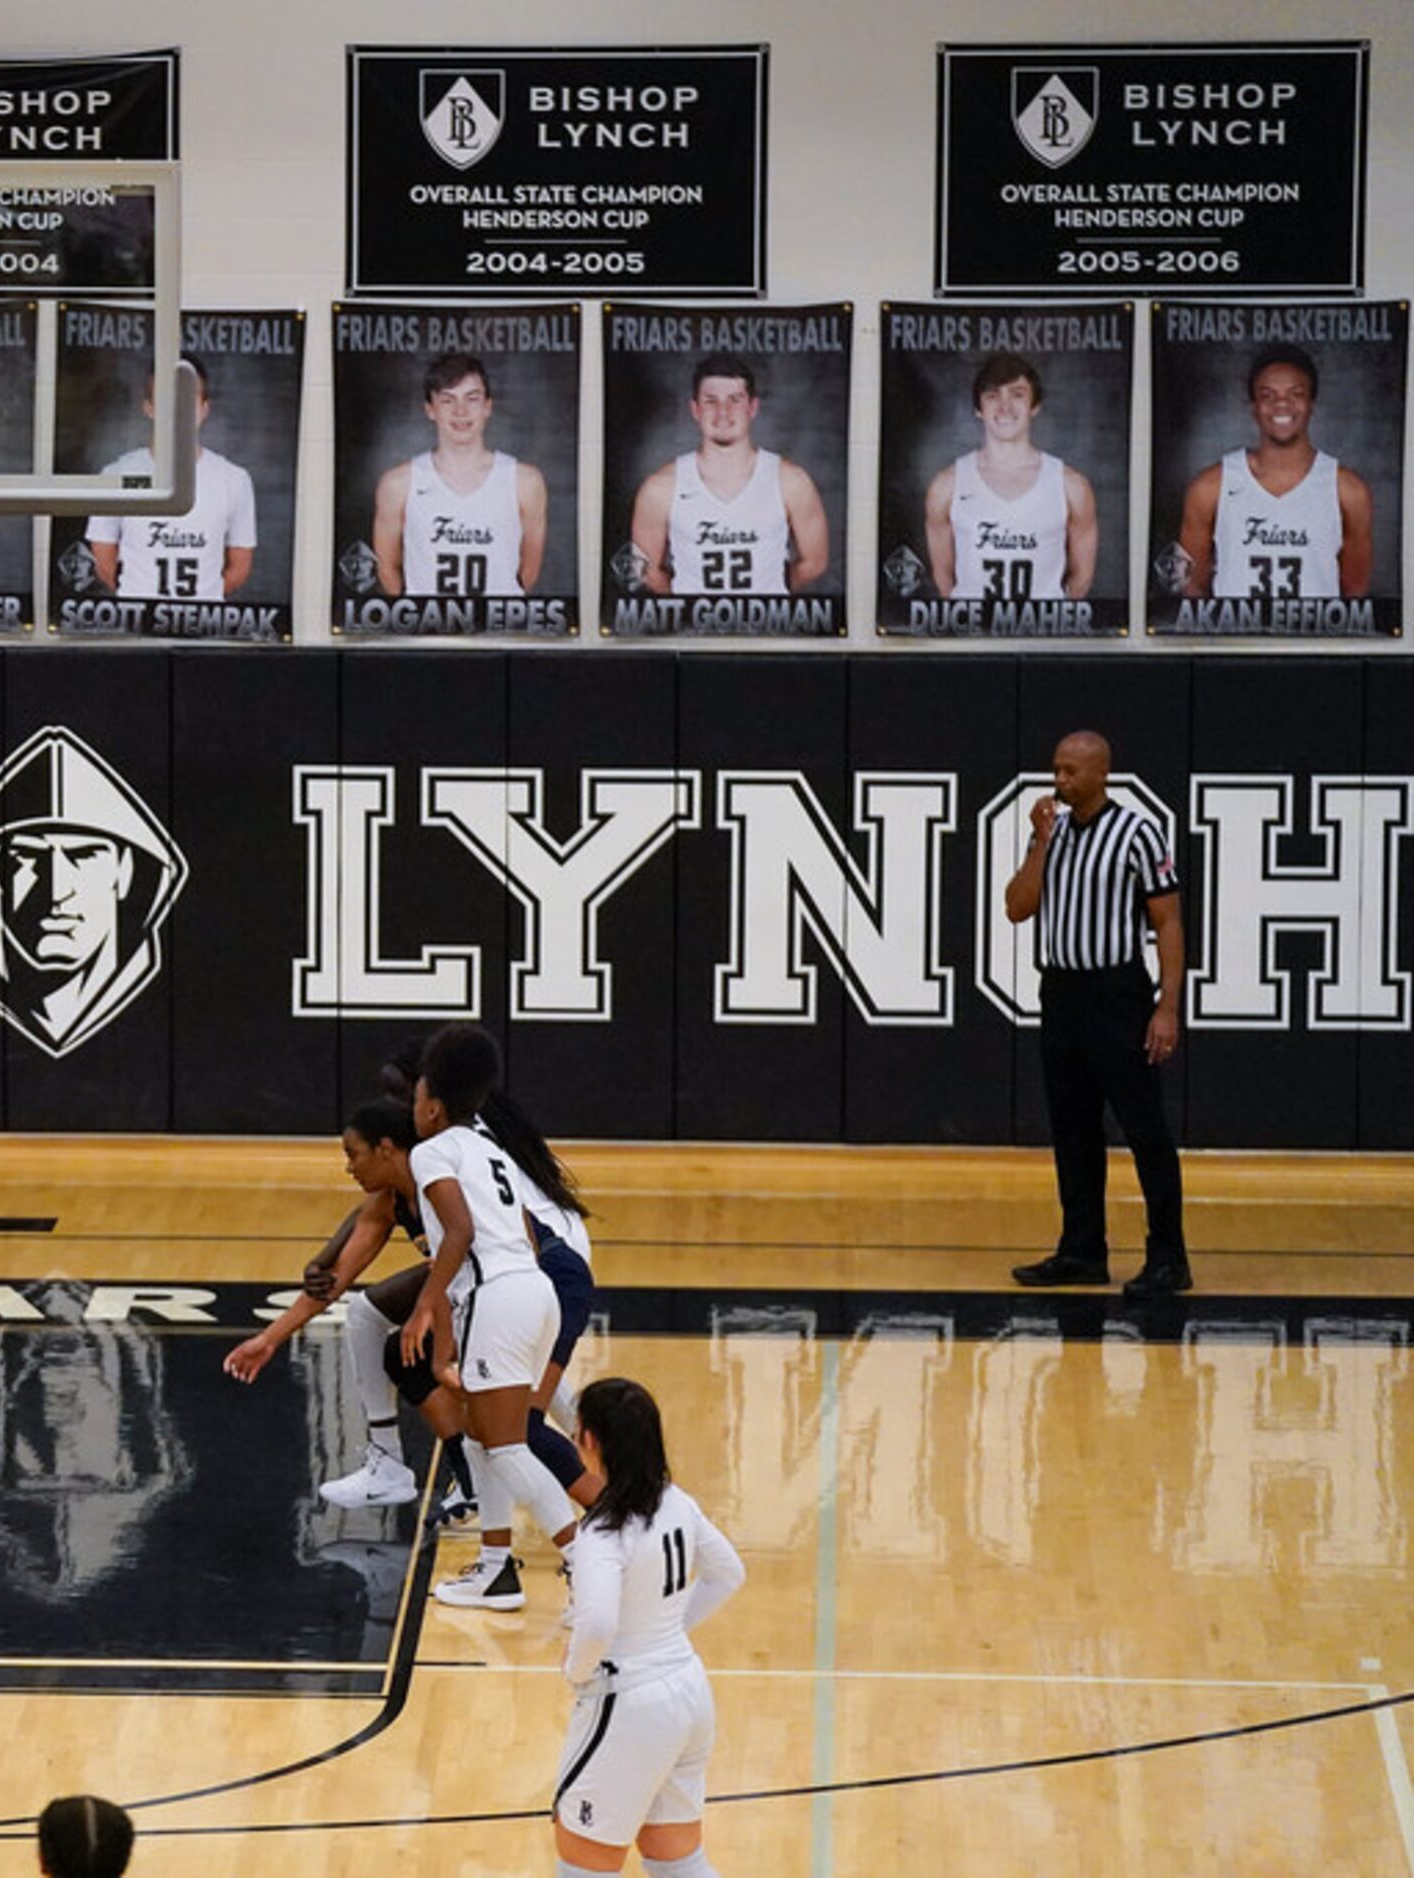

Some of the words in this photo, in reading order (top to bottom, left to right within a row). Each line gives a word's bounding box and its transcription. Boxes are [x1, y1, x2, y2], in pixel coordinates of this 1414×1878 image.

[529, 87, 699, 111] BISHOP
[1123, 84, 1297, 109] BISHOP
[538, 123, 688, 148] LYNCH
[1132, 120, 1286, 146] LYNCH
[410, 185, 509, 204] OVERALL
[513, 185, 576, 204] STATE
[582, 185, 702, 204] CHAMPION
[1001, 184, 1101, 203] OVERALL
[1107, 184, 1171, 203] STATE
[1176, 184, 1299, 203] CHAMPION
[18, 212, 63, 230] CUP
[463, 210, 599, 229] HENDERSON
[603, 210, 649, 229] CUP
[1054, 208, 1192, 228] HENDERSON
[1197, 208, 1244, 228] CUP
[466, 252, 645, 274] 2004-2005
[1057, 250, 1240, 273] 2005-2006
[65, 311, 146, 348] FRIARS
[180, 318, 295, 353] SKETBALL
[336, 315, 420, 352] FRIARS
[427, 315, 574, 353] BASKETBALL
[612, 316, 692, 352] FRIARS
[700, 316, 843, 352] BASKETBALL
[890, 316, 971, 352] FRIARS
[979, 316, 1122, 352] BASKETBALL
[1167, 308, 1245, 341] FRIARS
[1253, 308, 1392, 342] BASKETBALL
[147, 521, 208, 549] Friars
[431, 516, 494, 545] Friars
[696, 520, 759, 546] Friars
[975, 521, 1038, 550] Friars
[1242, 516, 1310, 546] Friars
[156, 558, 199, 598] 15
[437, 553, 487, 596] 20
[702, 550, 752, 590] 22
[983, 559, 1033, 600] 30
[1250, 555, 1303, 599] 33
[60, 599, 146, 629] SCOTT
[153, 603, 279, 635] STEMPAK
[344, 598, 474, 633] LOGAN
[486, 600, 566, 634] EPES
[615, 598, 685, 631] MATT
[692, 599, 833, 634] GOLDMAN
[910, 601, 982, 633] DUCE
[991, 601, 1093, 635] MAHER
[1175, 599, 1263, 633] AKAN
[1271, 599, 1376, 634] EFFIOM
[487, 1157, 515, 1206] 5
[662, 1527, 687, 1599] 11
